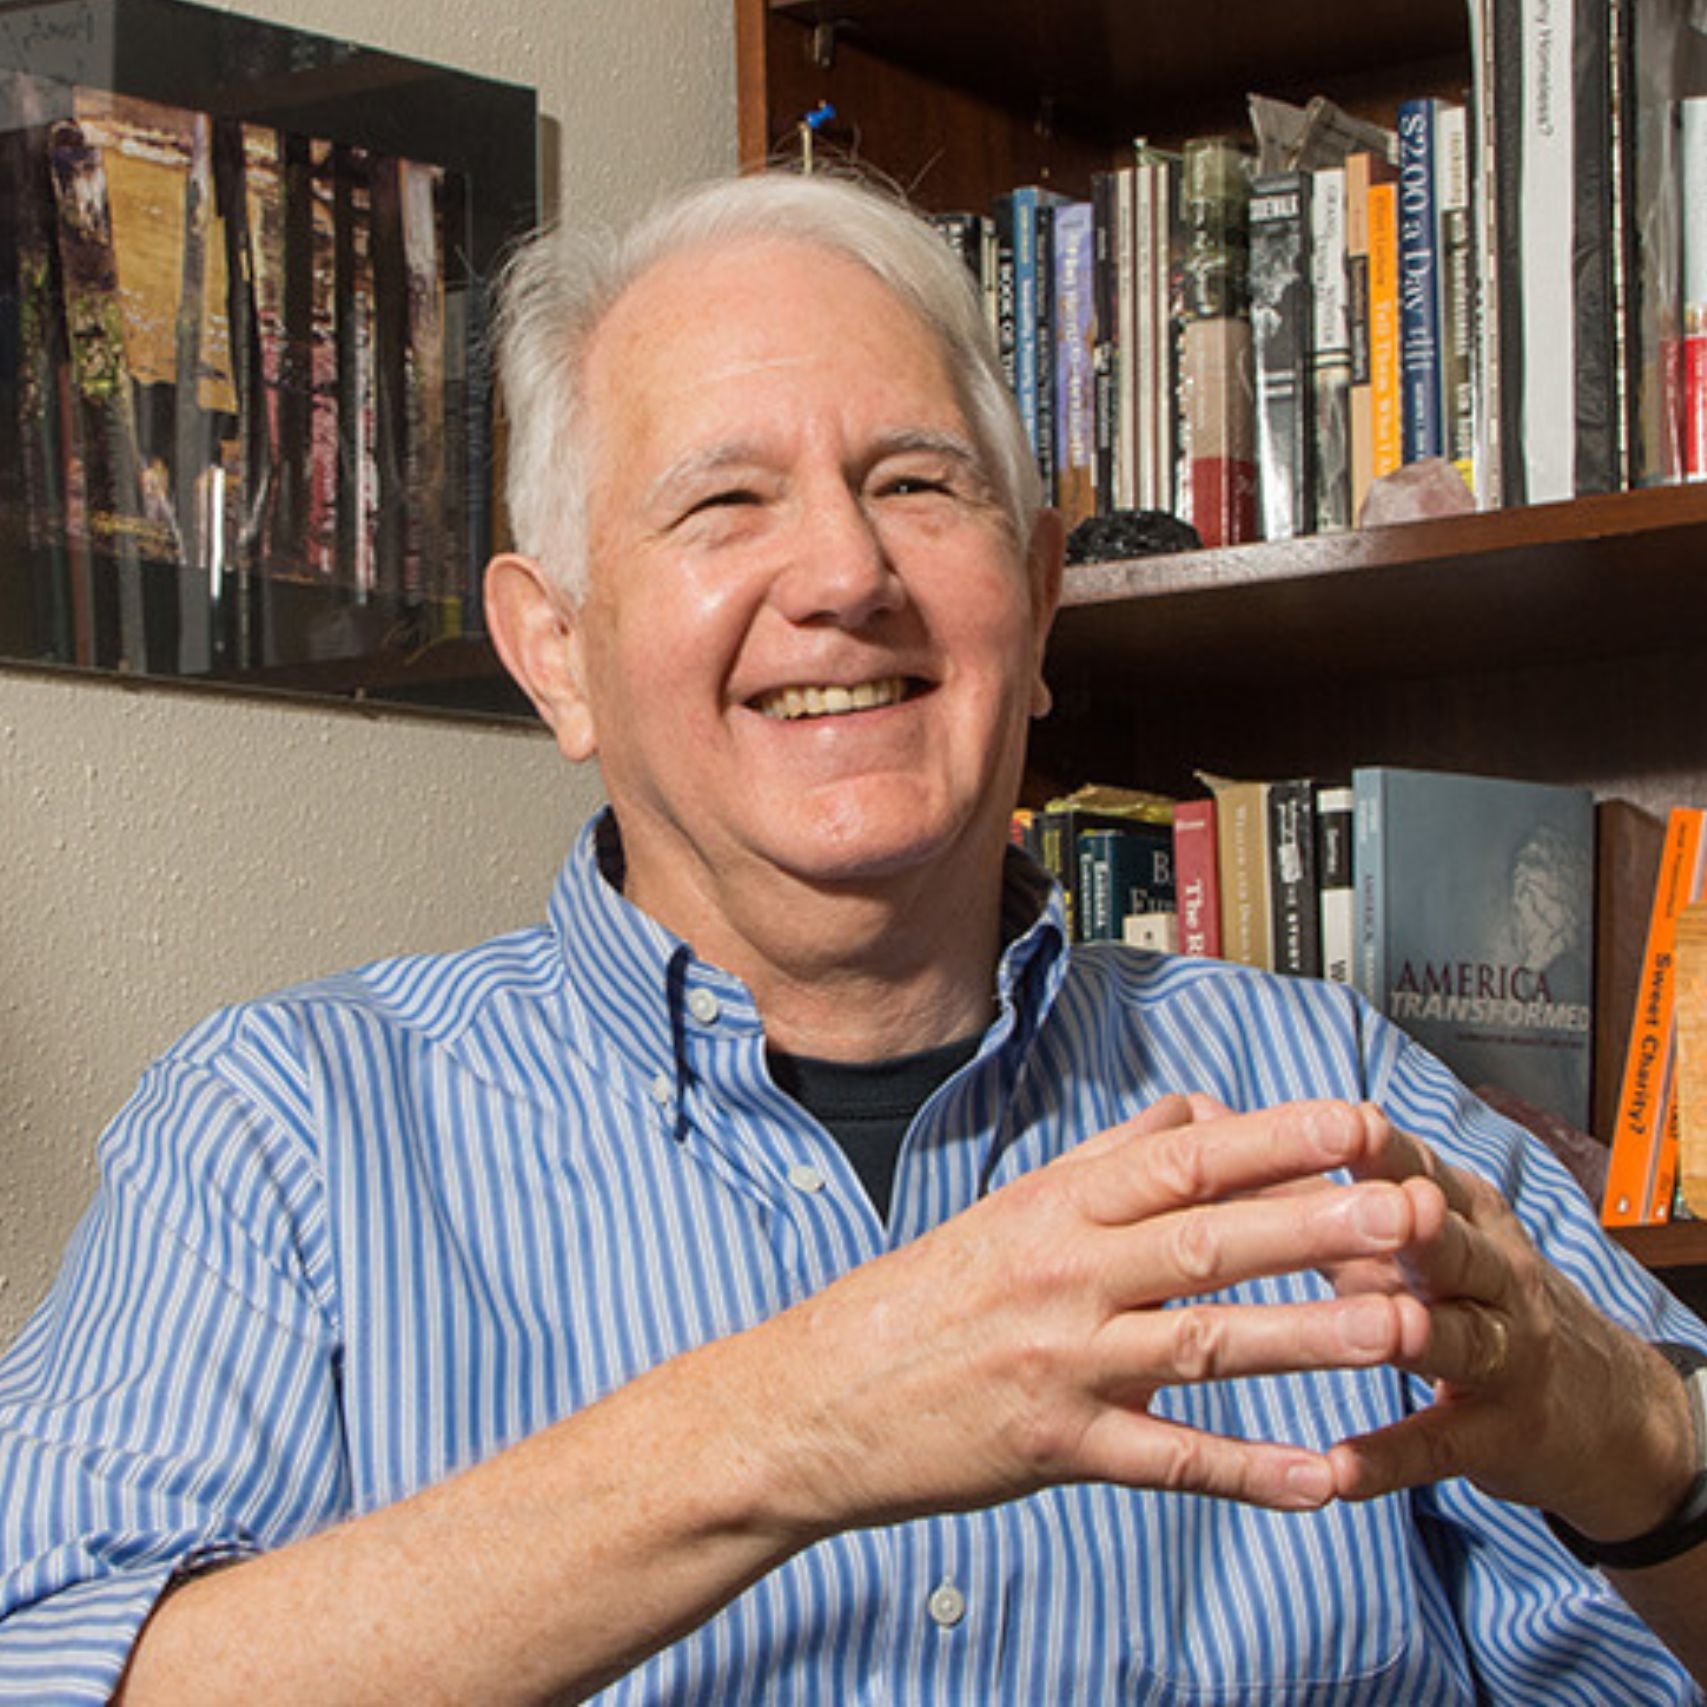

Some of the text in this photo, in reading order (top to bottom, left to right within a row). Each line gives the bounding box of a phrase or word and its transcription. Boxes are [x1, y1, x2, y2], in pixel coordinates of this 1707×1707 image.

[1400, 112, 1431, 314] $2.00 a Day
[1185, 878, 1203, 928] The
[1396, 958, 1552, 1002] AMERICA
[1390, 989, 1590, 1031] TRANSFORMED
[1625, 952, 1672, 1136] Sweet Charity?
